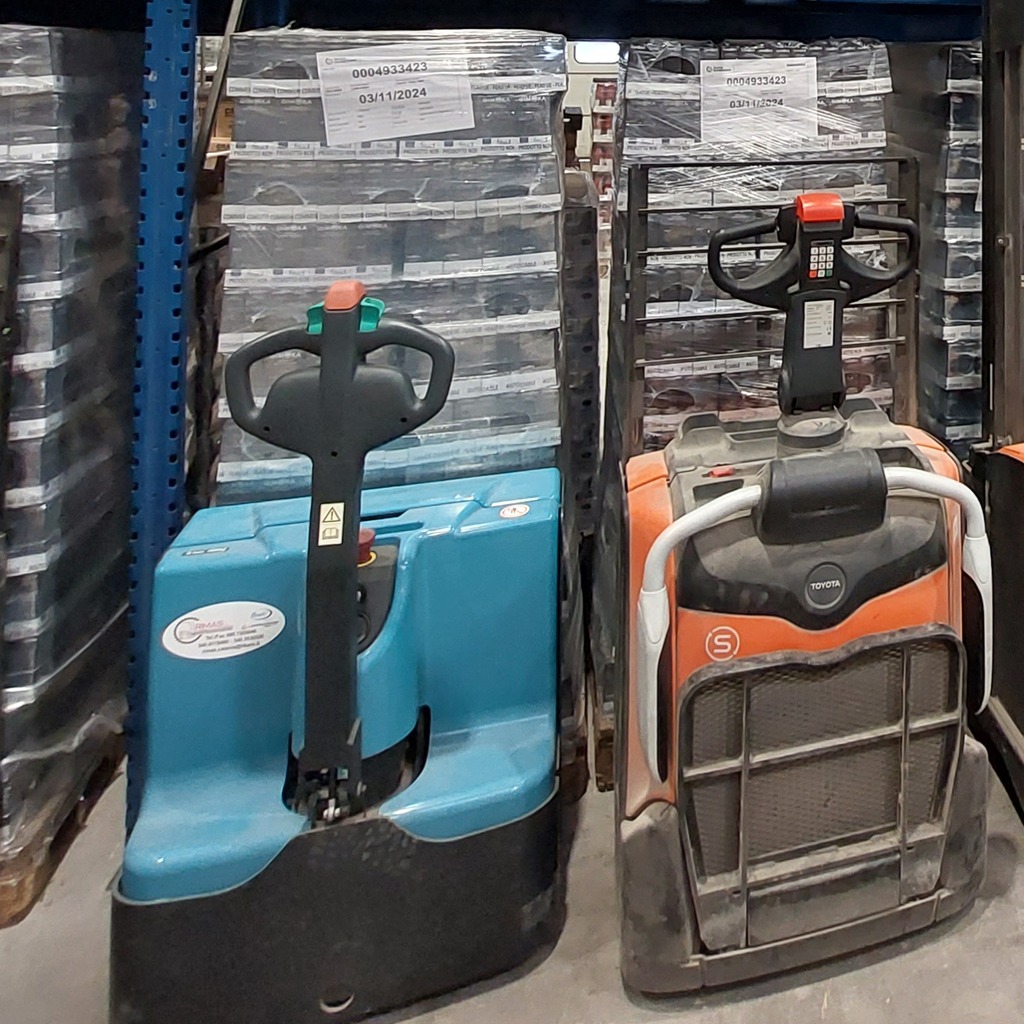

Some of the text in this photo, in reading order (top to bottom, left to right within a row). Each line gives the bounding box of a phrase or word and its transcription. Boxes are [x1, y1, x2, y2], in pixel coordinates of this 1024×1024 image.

[352, 62, 428, 78] 0004933423
[726, 76, 787, 87] 0004933423
[359, 88, 427, 104] 03/11/2024
[810, 579, 841, 590] TOYOTA
[713, 634, 732, 653] S
